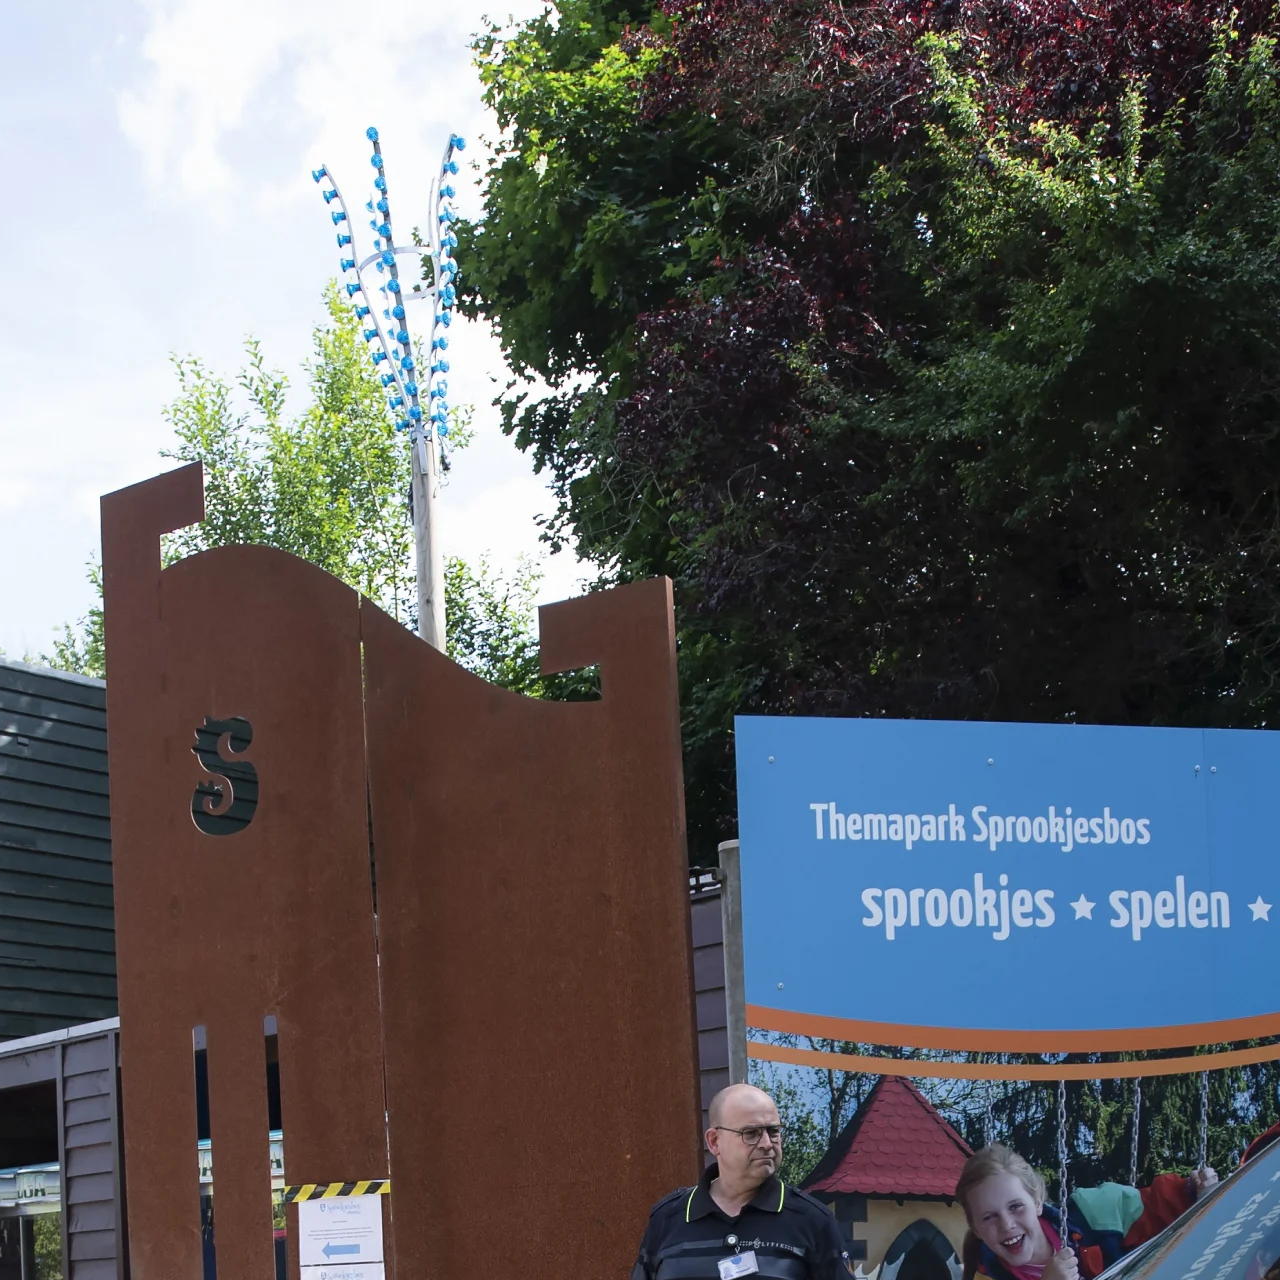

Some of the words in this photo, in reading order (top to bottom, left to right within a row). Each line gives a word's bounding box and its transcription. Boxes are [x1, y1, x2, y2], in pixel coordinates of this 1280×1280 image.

[809, 801, 966, 850] Themapark
[971, 805, 1151, 852] Sprookjesbos
[861, 872, 1056, 941] sprookjes
[1109, 875, 1231, 941] spelen
